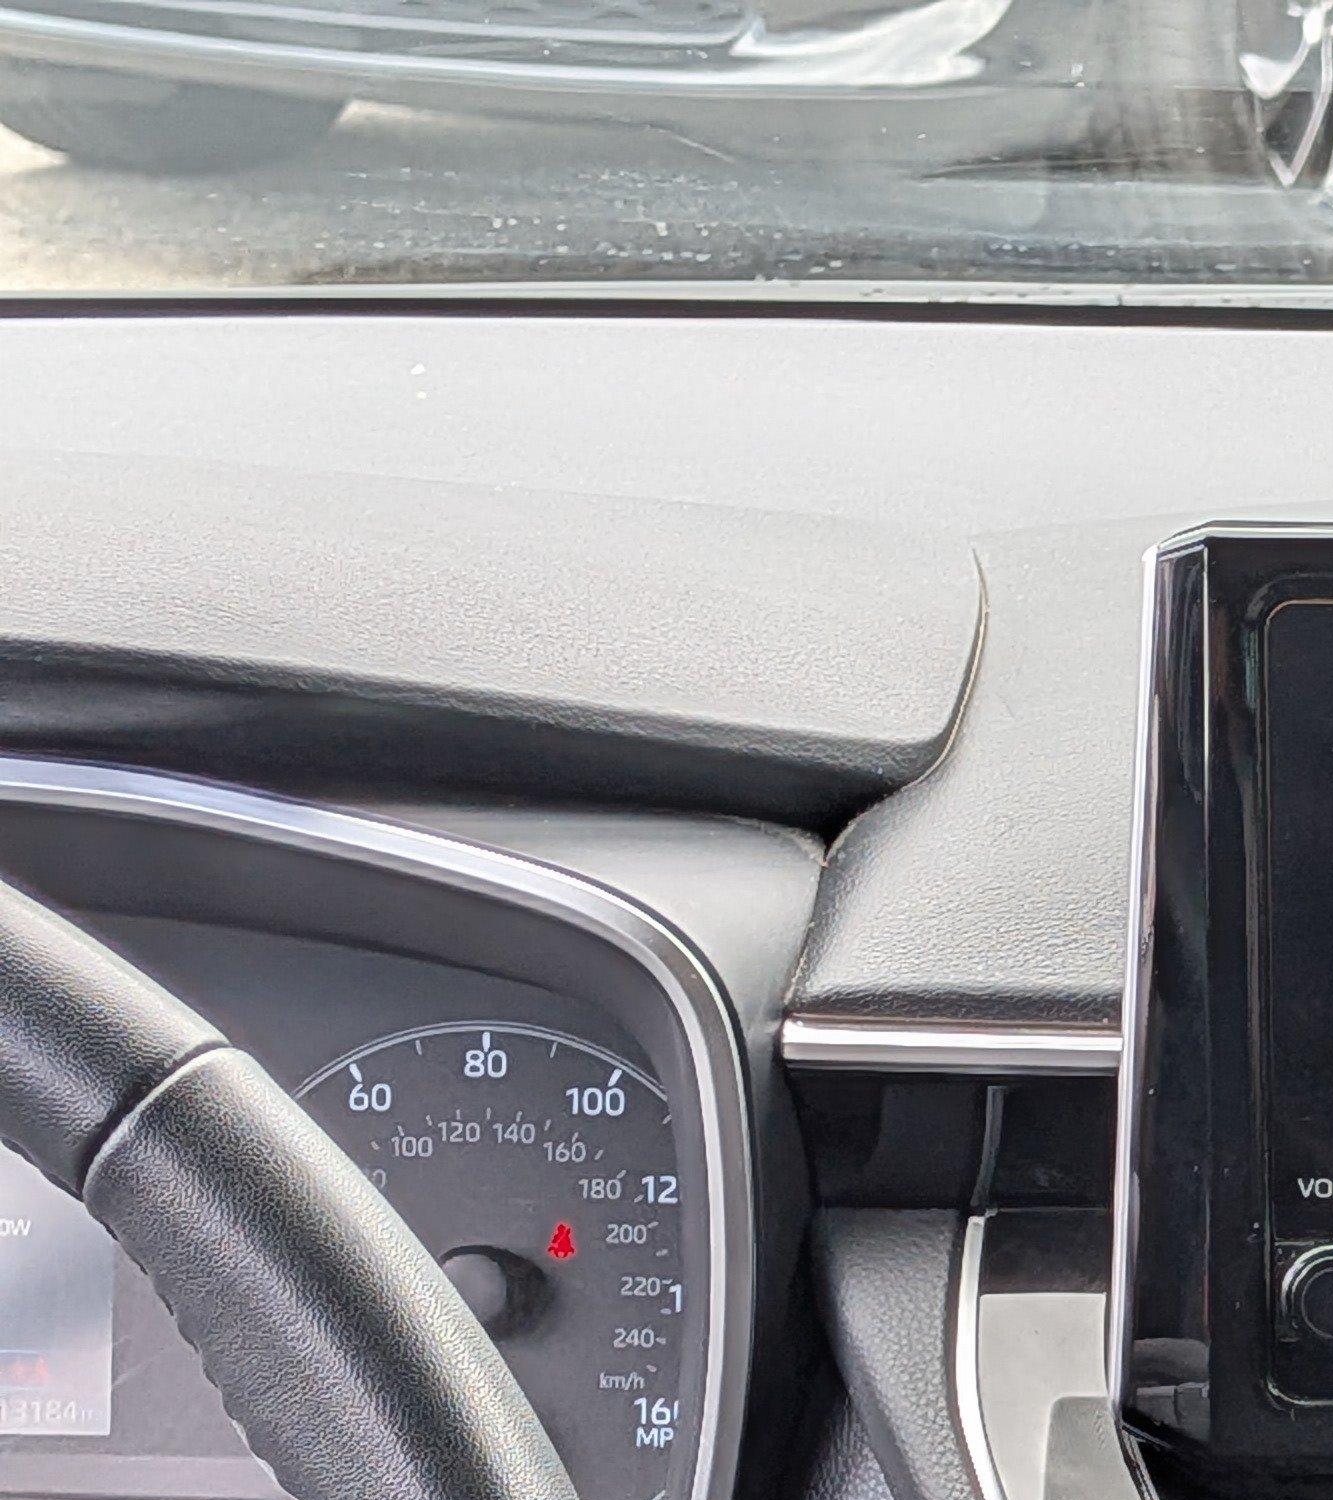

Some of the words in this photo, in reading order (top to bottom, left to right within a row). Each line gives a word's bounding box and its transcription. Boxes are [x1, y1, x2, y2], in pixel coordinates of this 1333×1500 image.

[463, 1049, 508, 1078] 80
[348, 1083, 392, 1112] 60
[565, 1086, 626, 1117] 100
[437, 1121, 481, 1143] 120
[492, 1122, 536, 1145] 140
[390, 1135, 434, 1158] 100
[543, 1140, 587, 1163] 160
[578, 1178, 622, 1200] 180
[605, 1223, 647, 1244] 200
[620, 1276, 661, 1297] 220
[612, 1327, 655, 1349] 240
[599, 1371, 645, 1391] km/h
